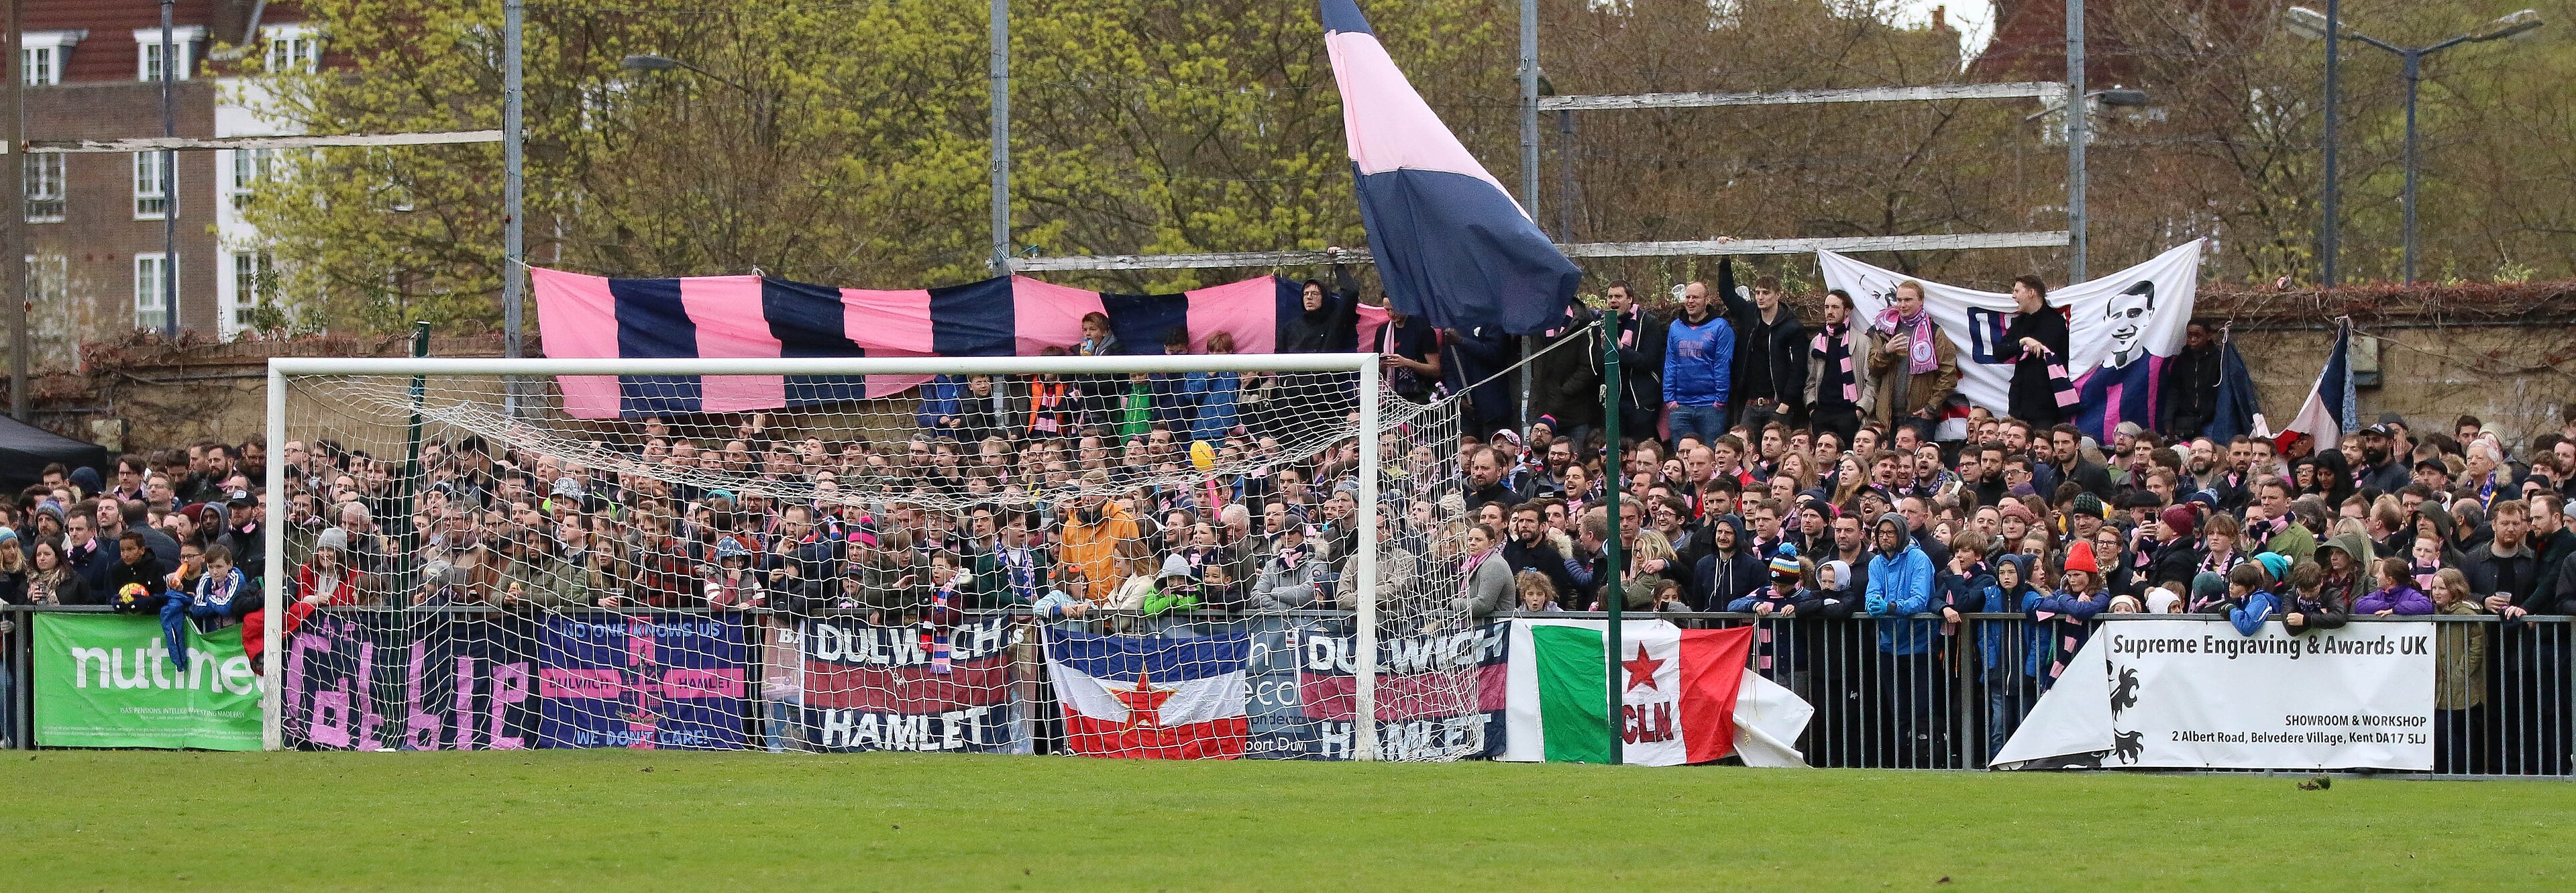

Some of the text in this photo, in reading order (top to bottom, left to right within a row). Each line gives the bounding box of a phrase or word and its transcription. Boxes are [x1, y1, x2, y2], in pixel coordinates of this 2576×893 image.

[563, 623, 720, 637] NO ONE KNOWS US
[816, 618, 1002, 664] DULWCH
[2113, 634, 2428, 660] Supreme Engraving & Awards UK
[549, 677, 731, 690] DULWICH HAMLET
[822, 706, 987, 751] HAMLET
[1621, 701, 1674, 745] CLN
[2286, 715, 2426, 727] SHOWROOM & WORKSHOP
[577, 729, 708, 745] WE DON'T CARE!
[2172, 731, 2426, 745] 2 Albert Road, Belvedere Village, Kent DA17 5LJ
